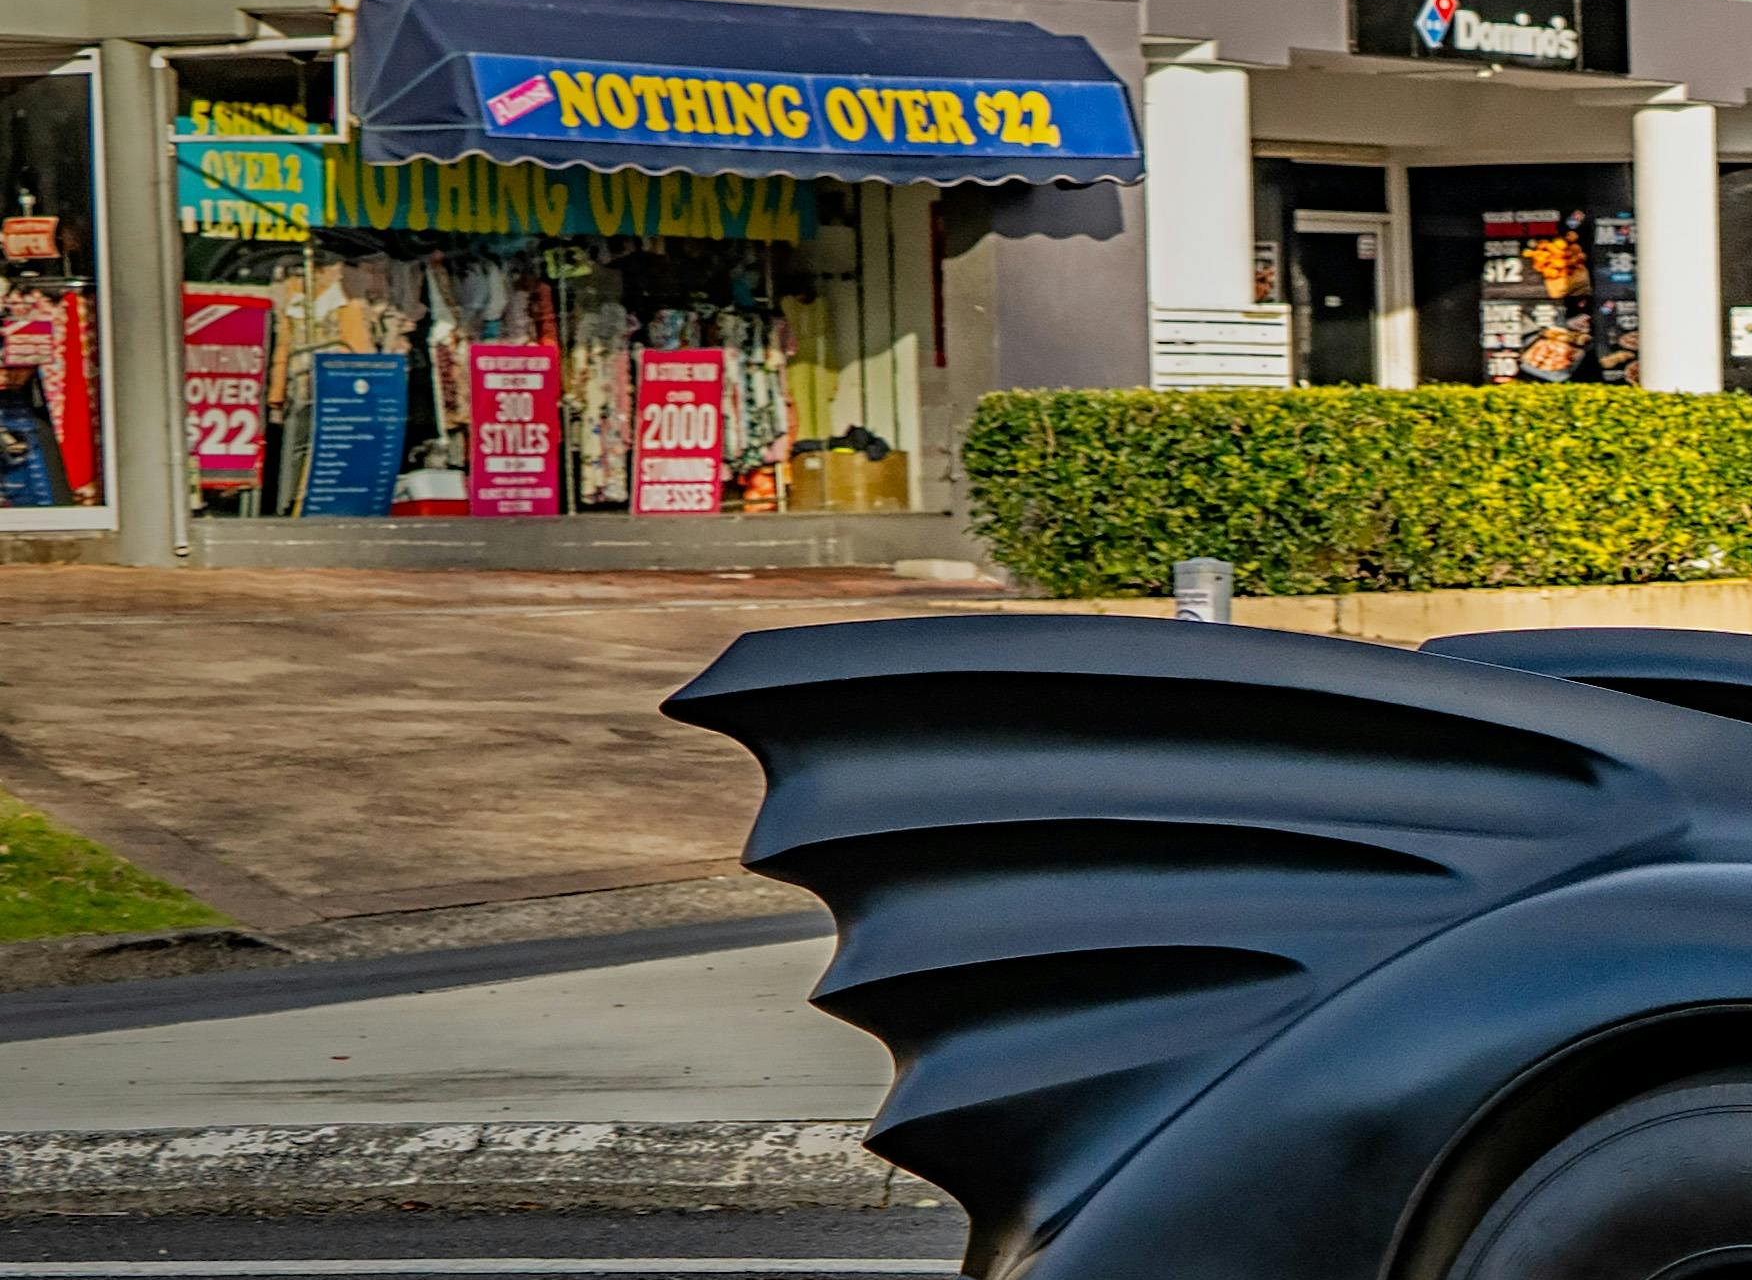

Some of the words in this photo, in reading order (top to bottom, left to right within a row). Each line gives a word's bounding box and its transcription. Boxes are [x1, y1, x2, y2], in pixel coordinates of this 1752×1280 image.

[1455, 10, 1578, 60] Domino's
[491, 75, 556, 125] Almost
[549, 71, 811, 140] NOTHING
[825, 86, 978, 147] OVER
[976, 88, 1062, 149] $22
[202, 151, 281, 191] OVER
[282, 152, 304, 192] 2
[200, 200, 312, 243] LEVELS
[186, 377, 259, 406] OVER
[186, 409, 260, 456] $22
[479, 423, 550, 455] STYLES
[642, 403, 718, 450] 2000
